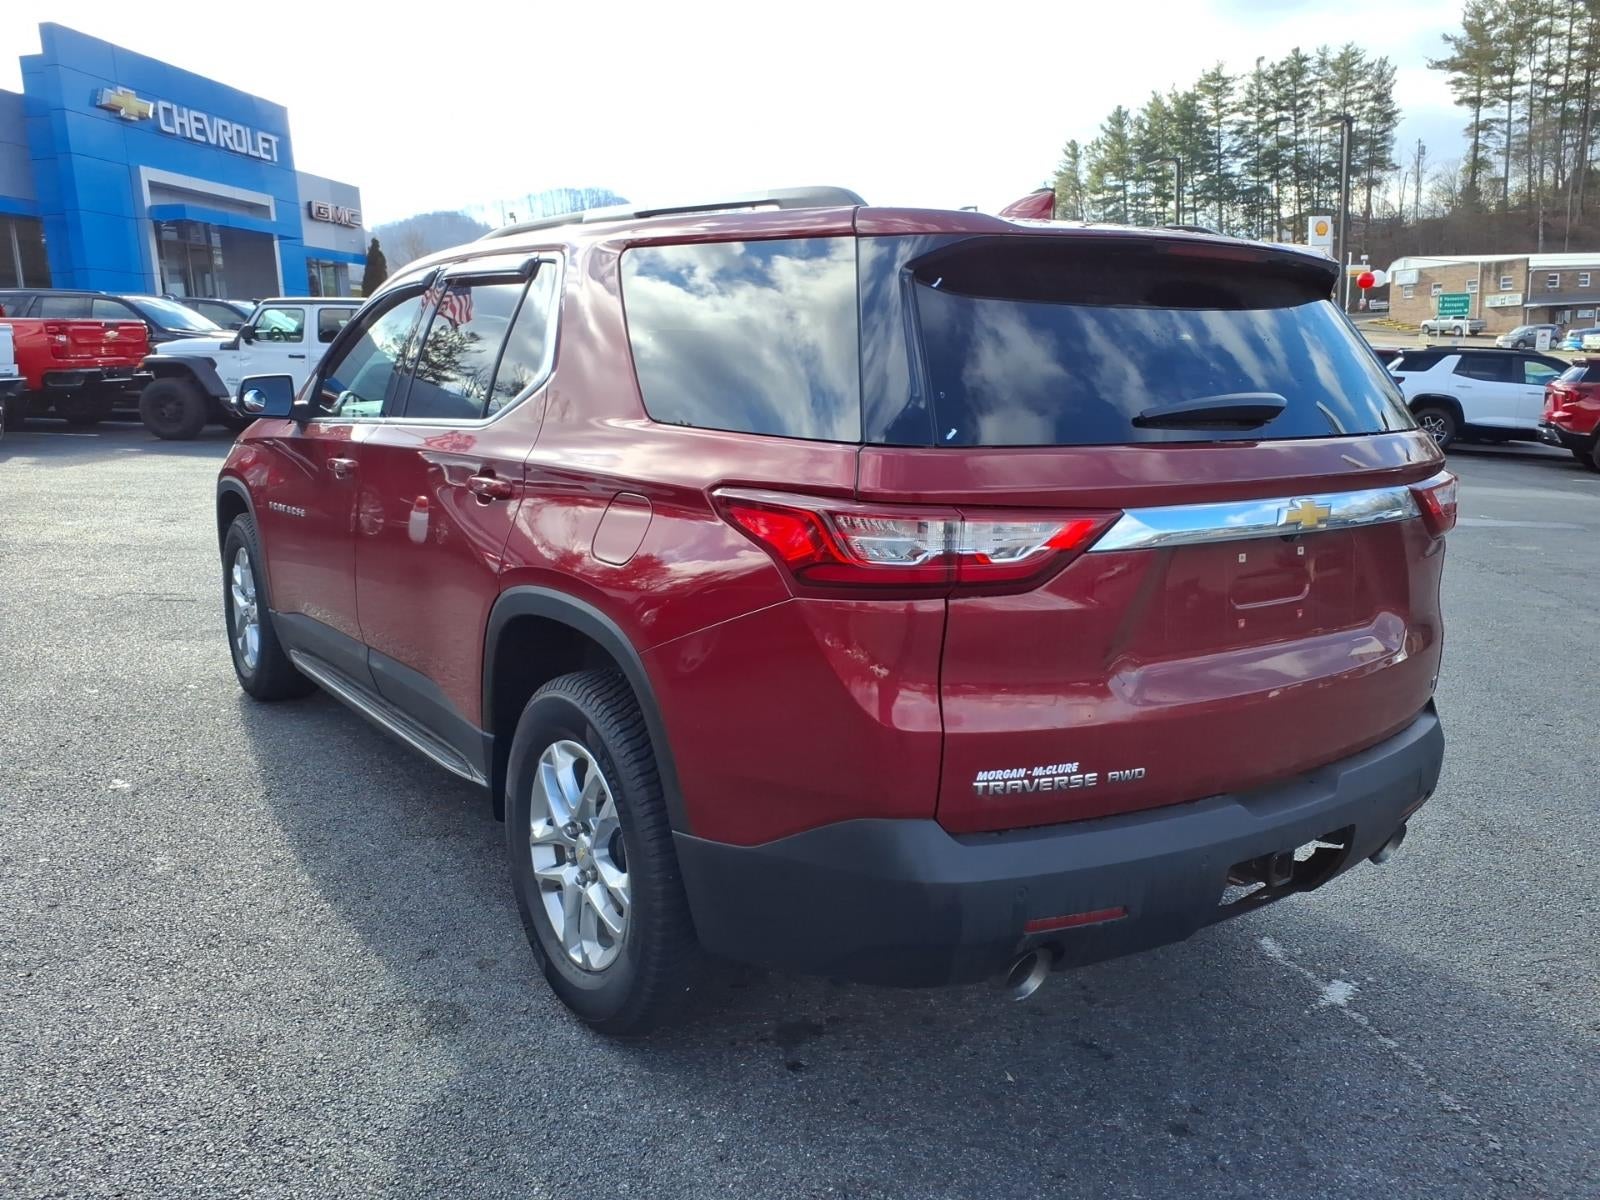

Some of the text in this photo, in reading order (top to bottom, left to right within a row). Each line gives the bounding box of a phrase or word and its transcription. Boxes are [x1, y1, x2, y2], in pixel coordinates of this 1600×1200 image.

[157, 100, 279, 162] CHEVROLET
[308, 200, 361, 228] GMC
[972, 767, 1146, 796] TRAVERSE AWD
